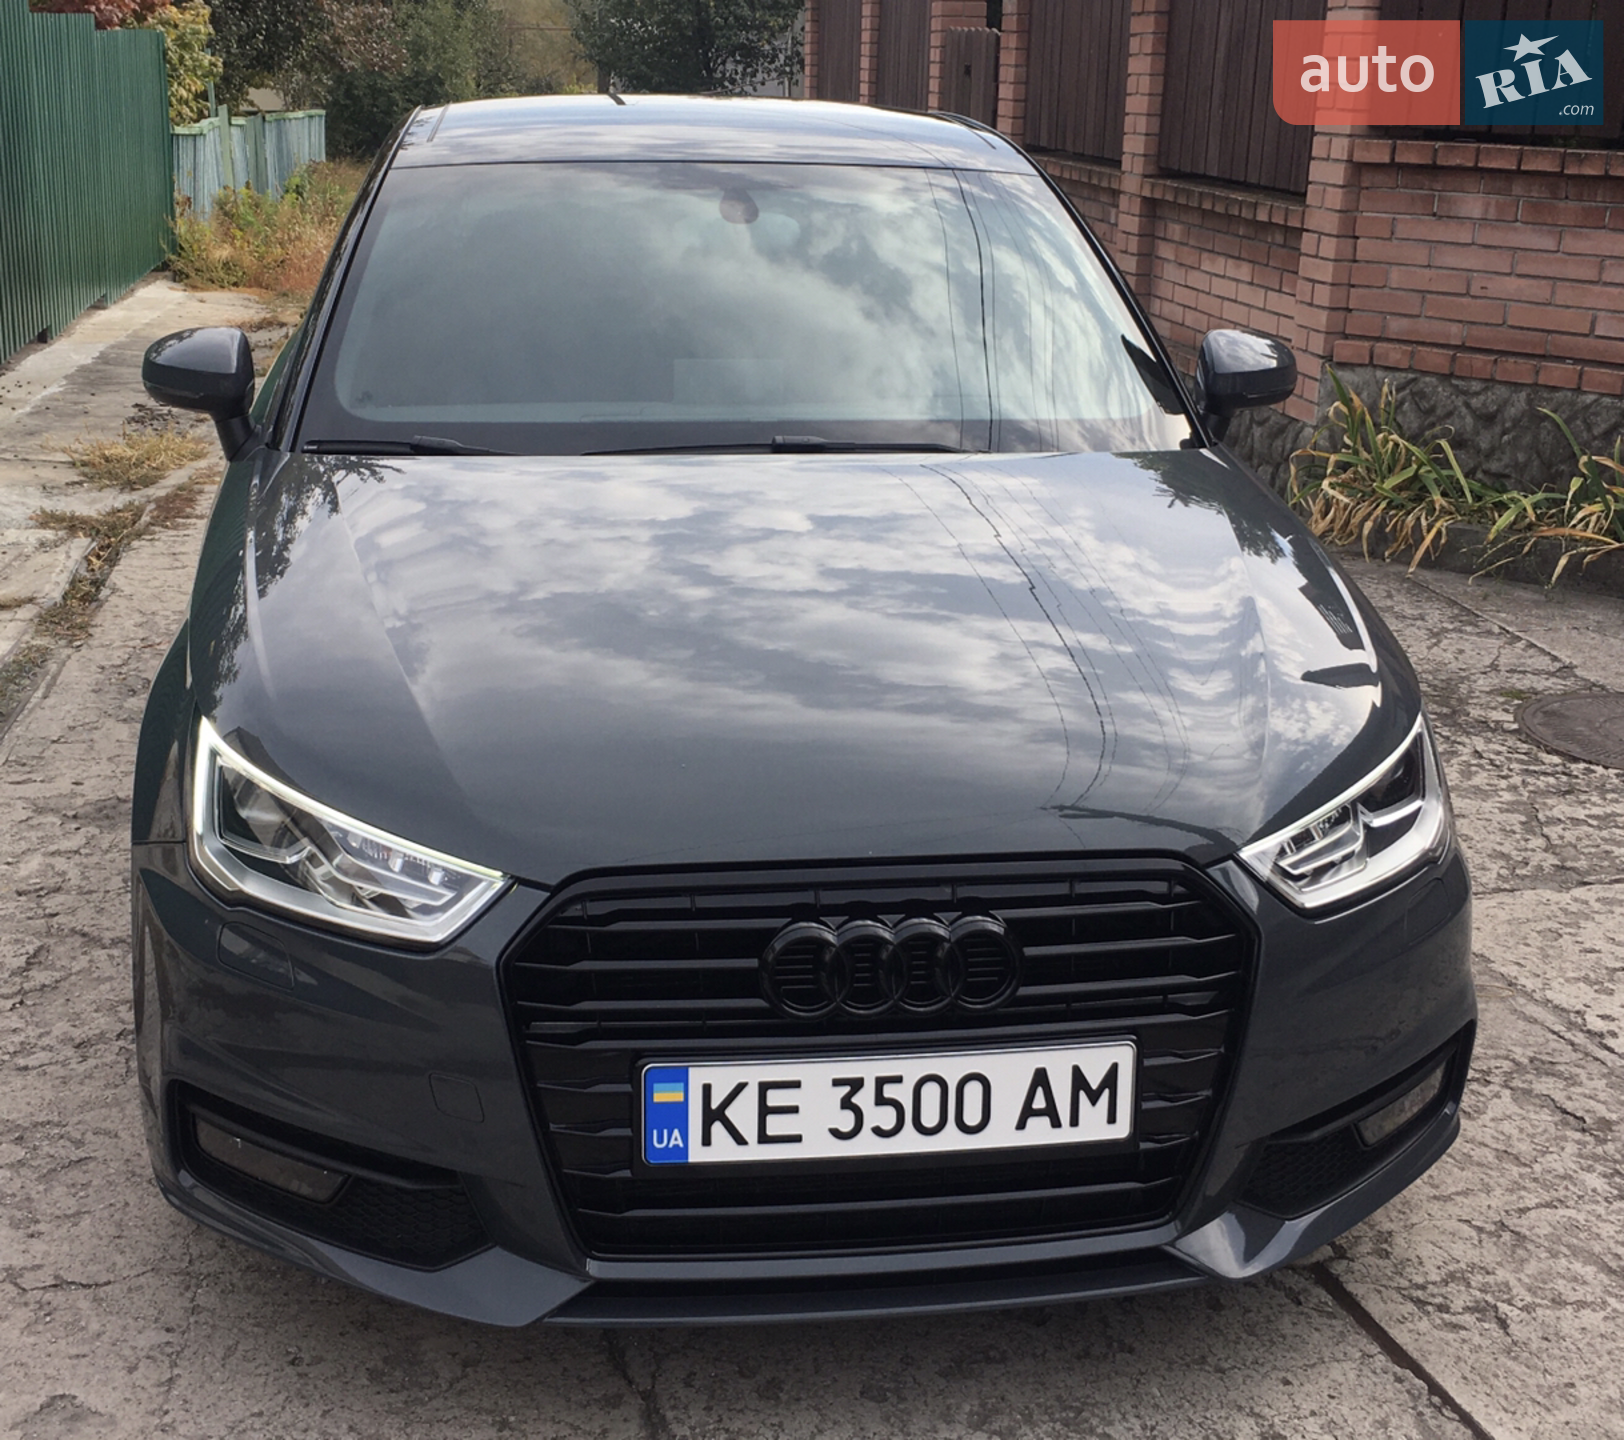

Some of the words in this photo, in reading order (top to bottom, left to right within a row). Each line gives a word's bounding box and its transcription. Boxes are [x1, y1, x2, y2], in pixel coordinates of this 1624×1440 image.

[701, 1080, 803, 1147] KE
[828, 1072, 992, 1140] 3500
[1015, 1062, 1119, 1131] AM
[652, 1128, 684, 1149] UA
